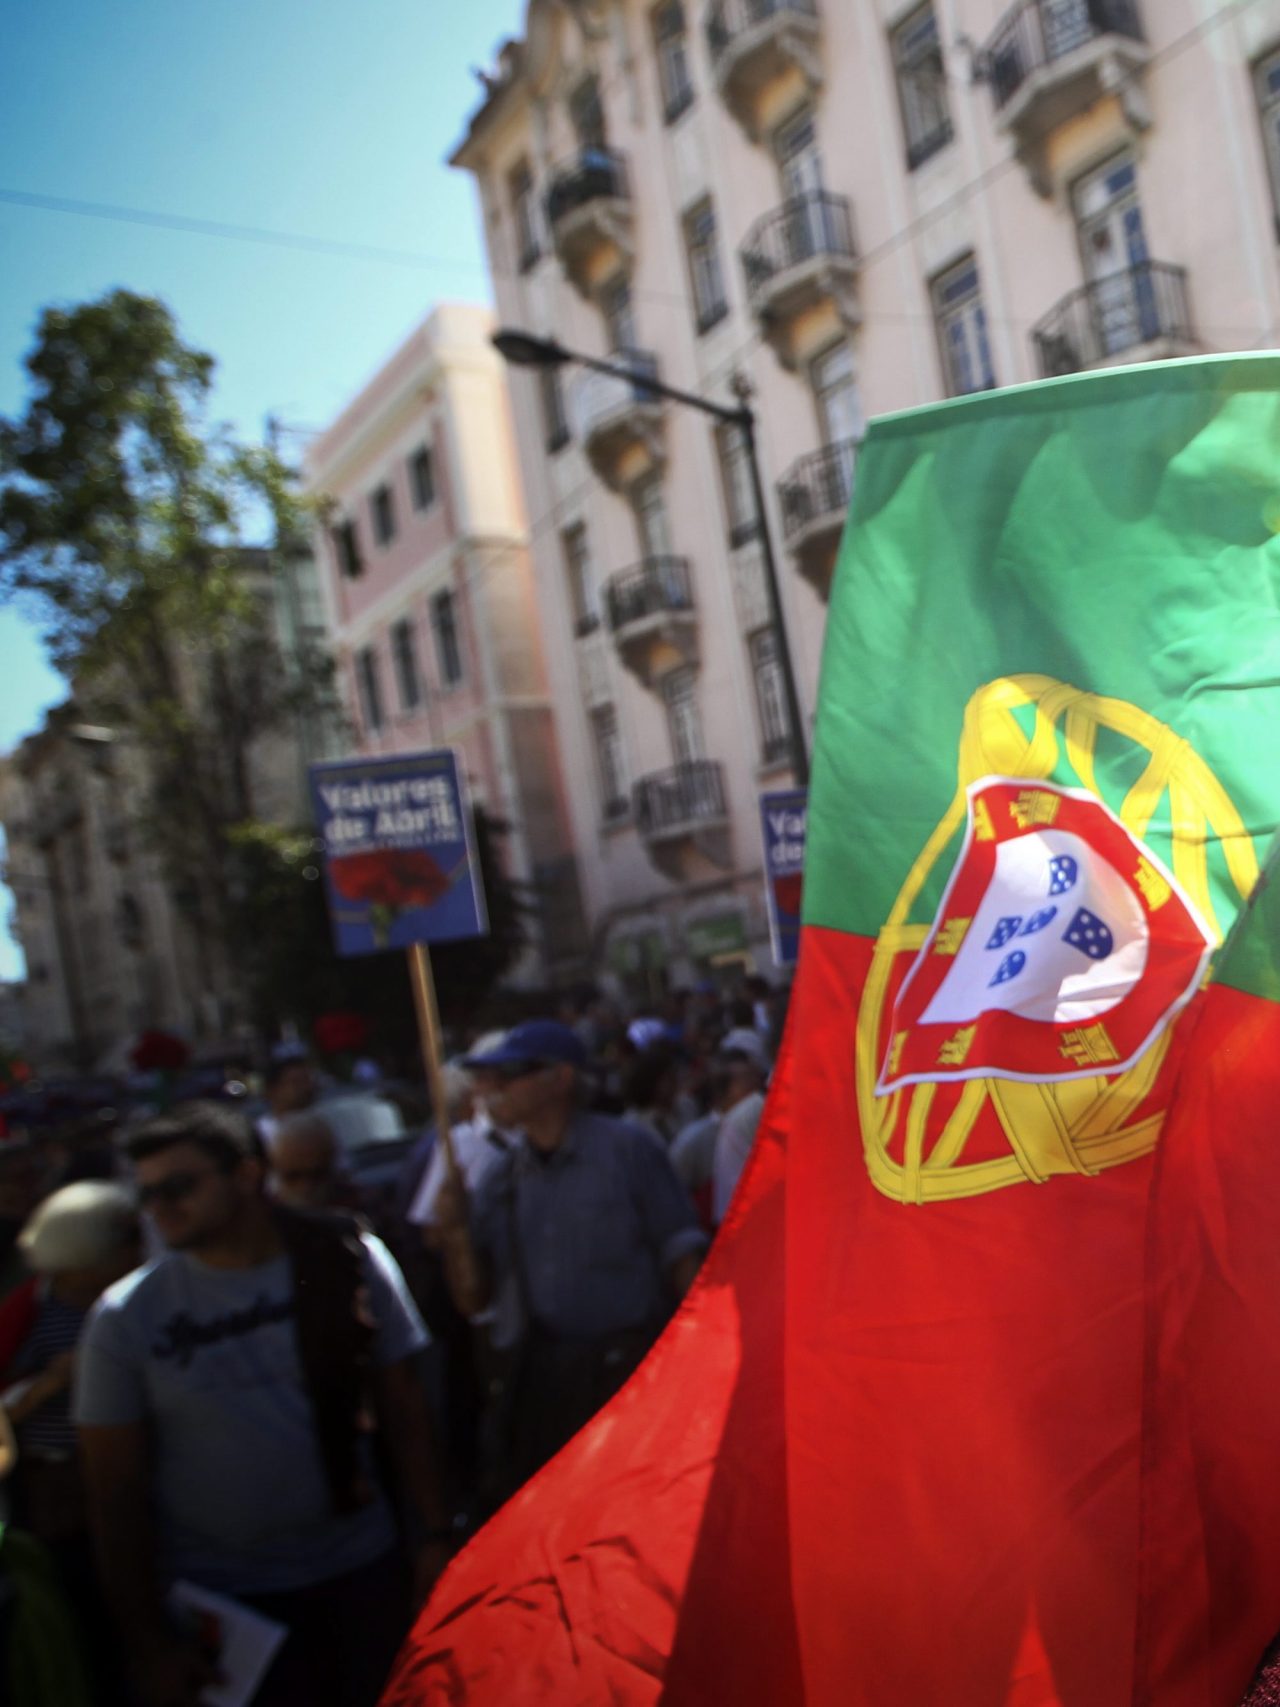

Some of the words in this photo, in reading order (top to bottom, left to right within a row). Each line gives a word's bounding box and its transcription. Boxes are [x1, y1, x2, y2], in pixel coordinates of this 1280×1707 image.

[319, 775, 450, 812] Valores
[326, 814, 366, 842] de
[374, 801, 457, 834] Abril
